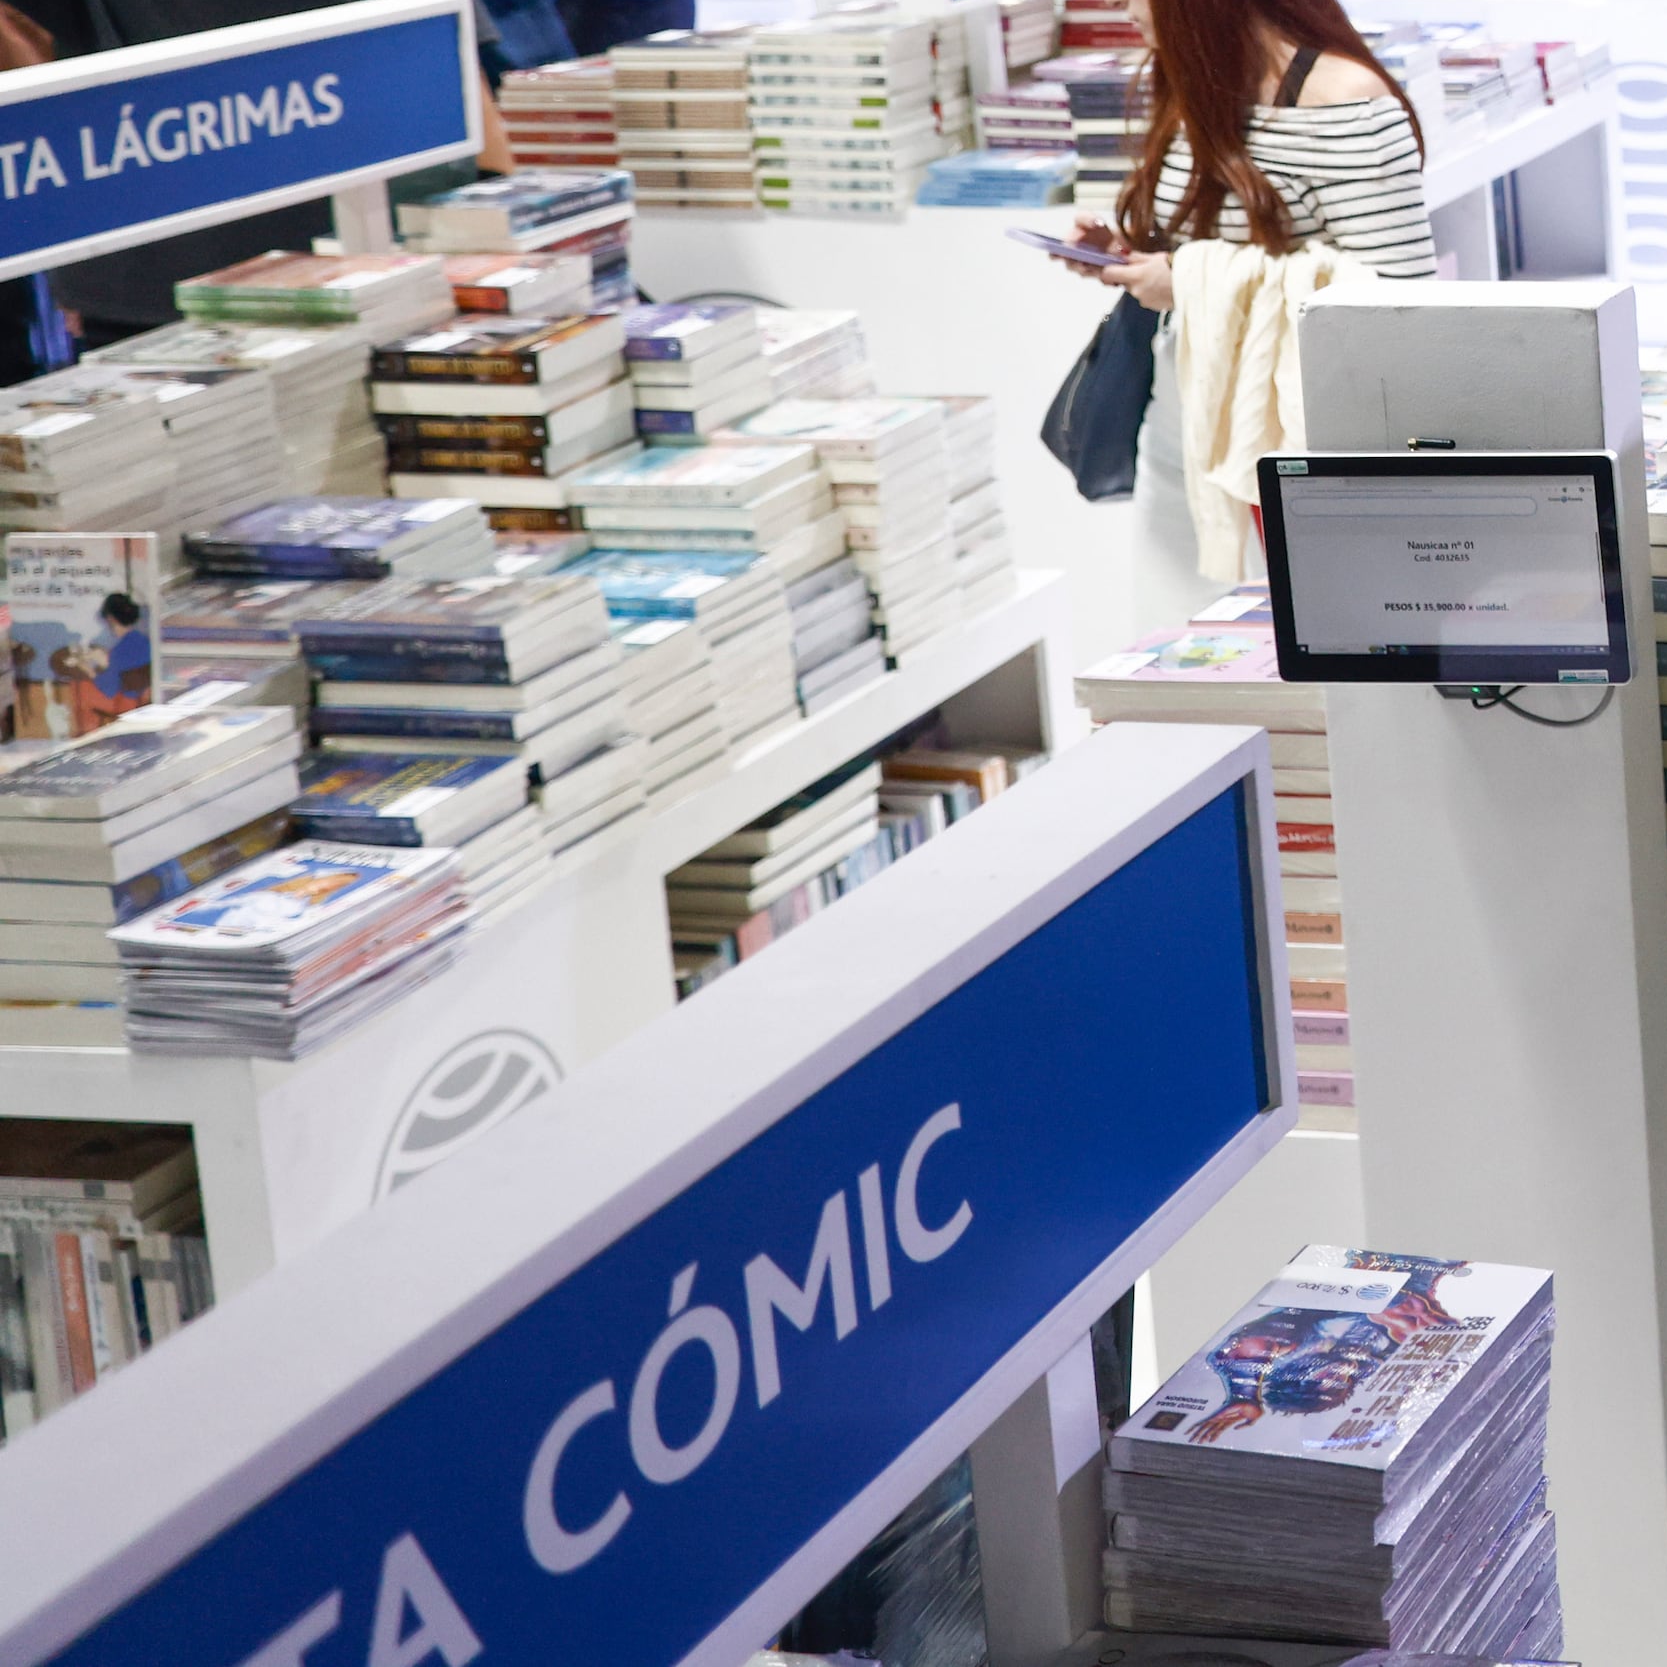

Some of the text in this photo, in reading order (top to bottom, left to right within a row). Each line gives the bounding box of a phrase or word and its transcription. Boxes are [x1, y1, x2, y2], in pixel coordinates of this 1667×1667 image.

[79, 73, 344, 181] LÁGRIMAS
[1384, 602, 1413, 611] PESOS
[523, 1102, 973, 1575] CÓMIC
